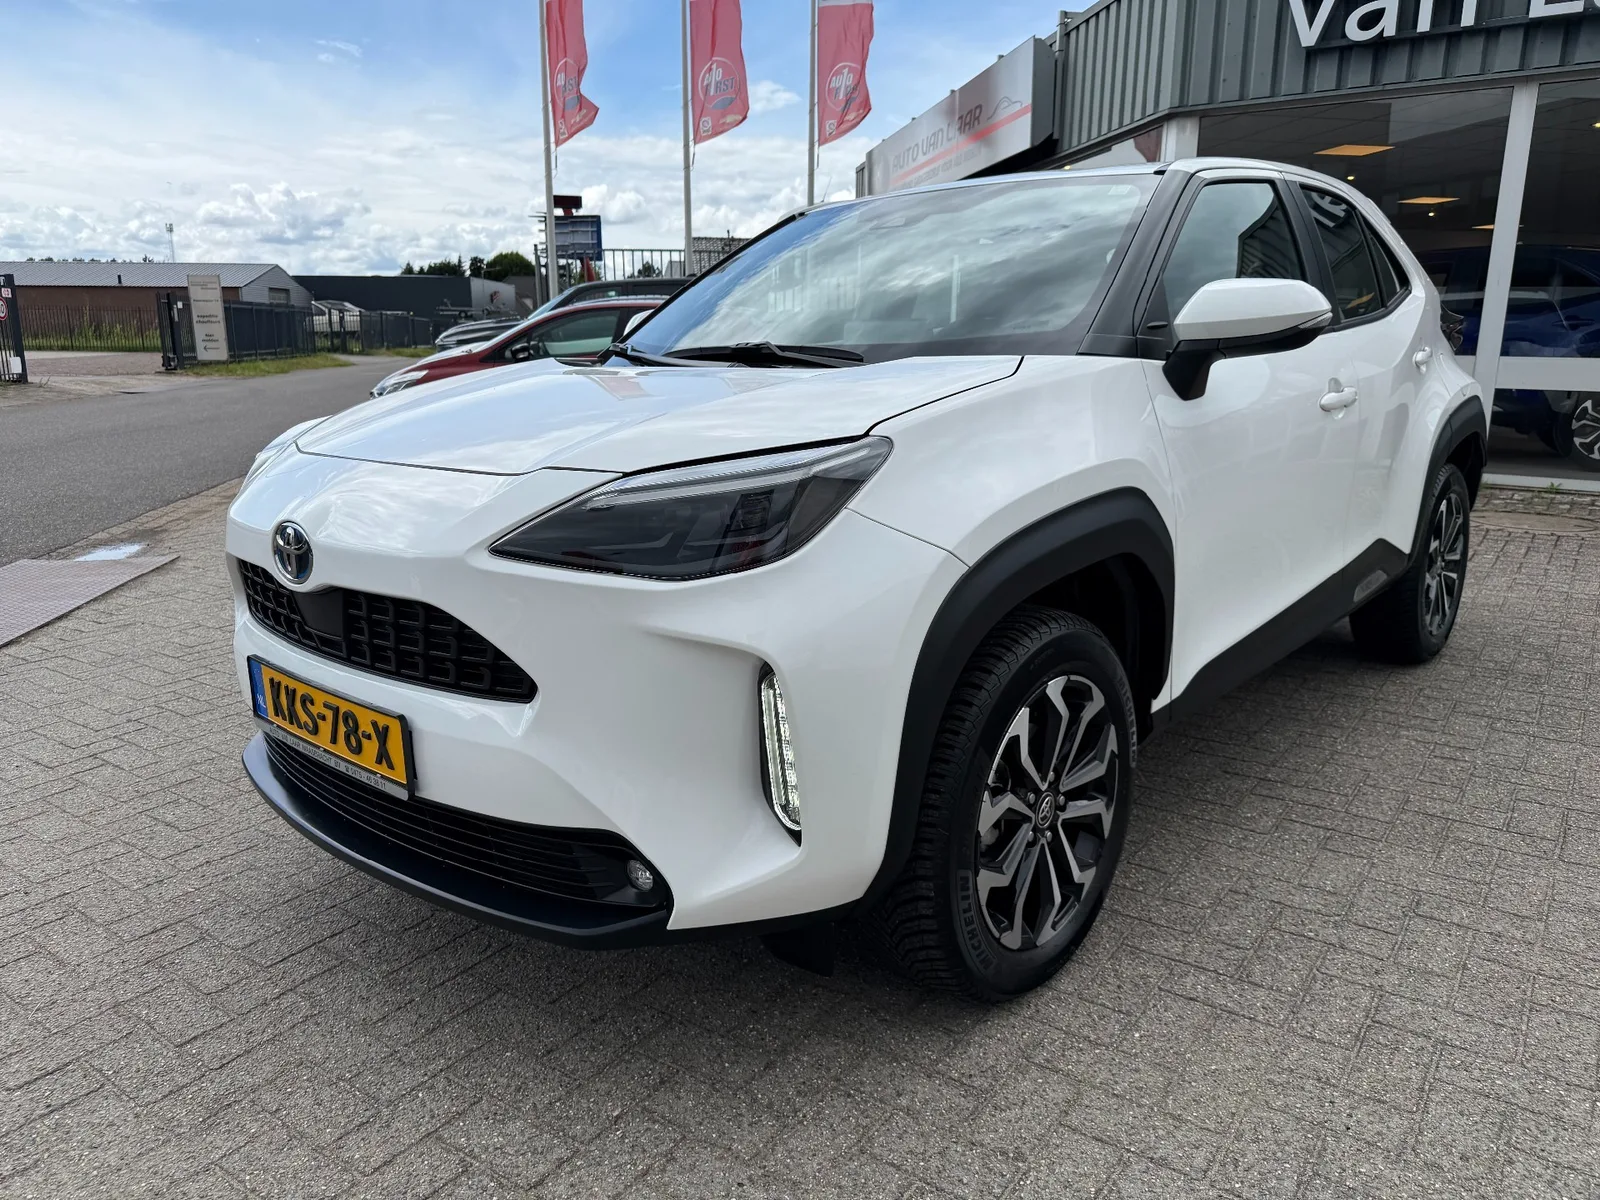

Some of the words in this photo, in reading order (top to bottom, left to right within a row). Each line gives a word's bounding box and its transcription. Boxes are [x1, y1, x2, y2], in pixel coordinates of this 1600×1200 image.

[891, 143, 920, 174] AUTO
[921, 128, 945, 157] VAN
[269, 677, 395, 771] KKS-78-X
[959, 875, 995, 971] MICHELIN
